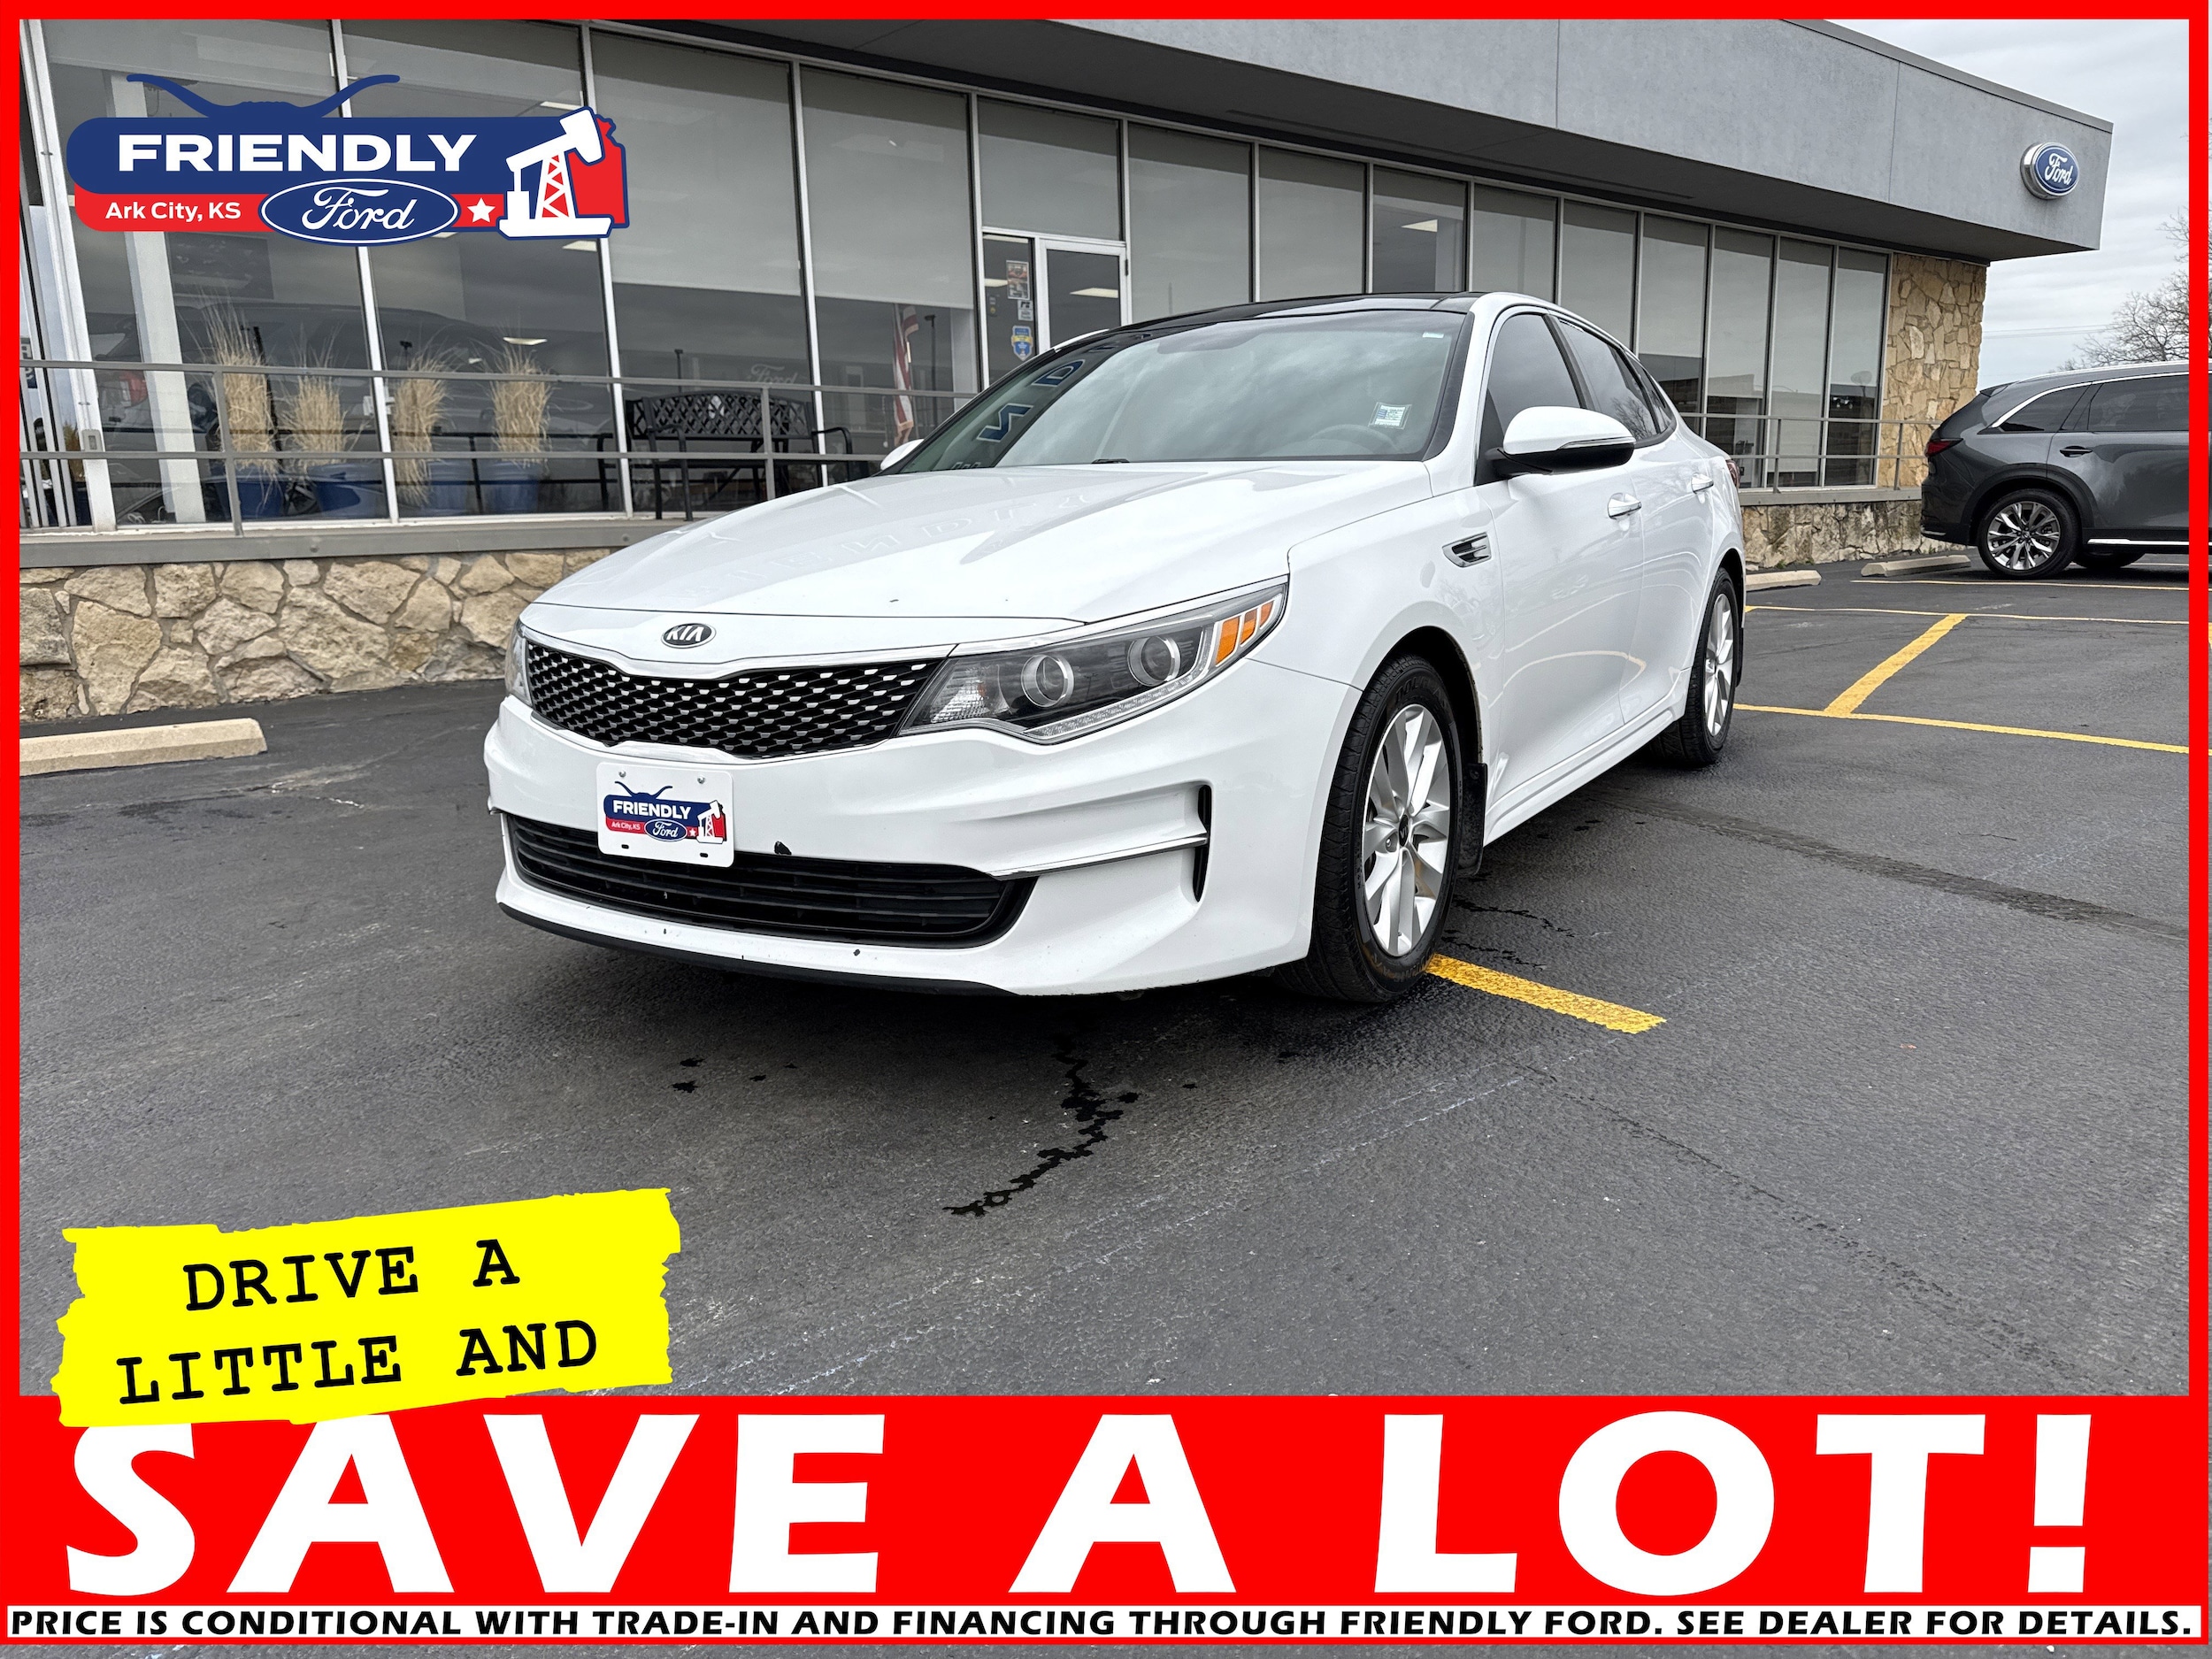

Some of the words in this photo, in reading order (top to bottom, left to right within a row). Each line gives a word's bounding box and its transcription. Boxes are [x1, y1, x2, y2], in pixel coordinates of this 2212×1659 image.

[2045, 153, 2073, 185] Ford
[666, 625, 704, 641] KIA
[612, 800, 691, 819] FRIENDLY
[652, 820, 679, 838] Ford
